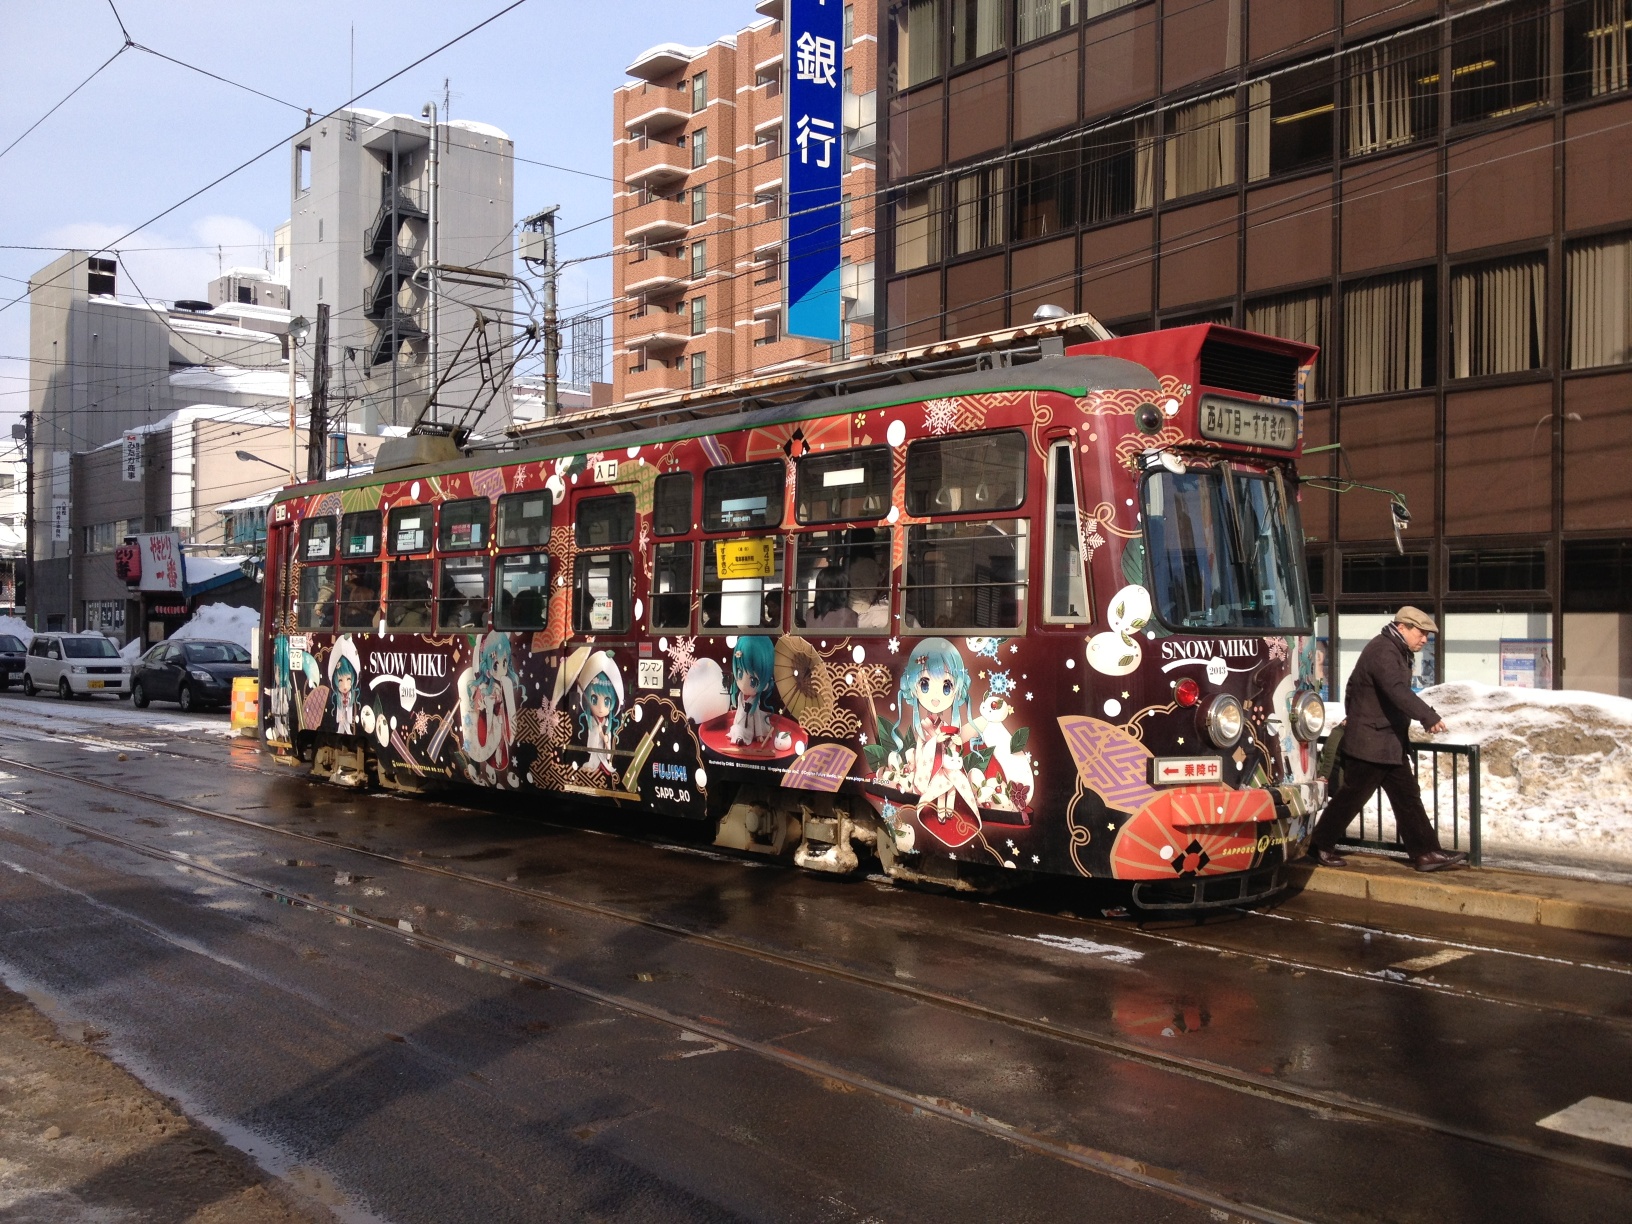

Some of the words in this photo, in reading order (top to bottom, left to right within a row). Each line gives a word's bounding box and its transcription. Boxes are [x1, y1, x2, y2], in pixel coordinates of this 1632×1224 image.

[796, 0, 837, 168] 銀行
[596, 464, 616, 479] 入口
[763, 544, 771, 574] 西4丁目
[1161, 640, 1215, 660] SNOW
[1218, 639, 1259, 657] MIKU
[369, 651, 408, 676] SNOW
[410, 653, 448, 678] MIKU
[640, 662, 662, 672] ワンマン
[1209, 666, 1226, 676] 2013
[643, 676, 659, 686] 入口
[401, 686, 416, 698] 2013
[653, 762, 687, 782] FUJIMI
[1185, 763, 1217, 776] 乗降中
[1222, 846, 1256, 856] SAPPORO
